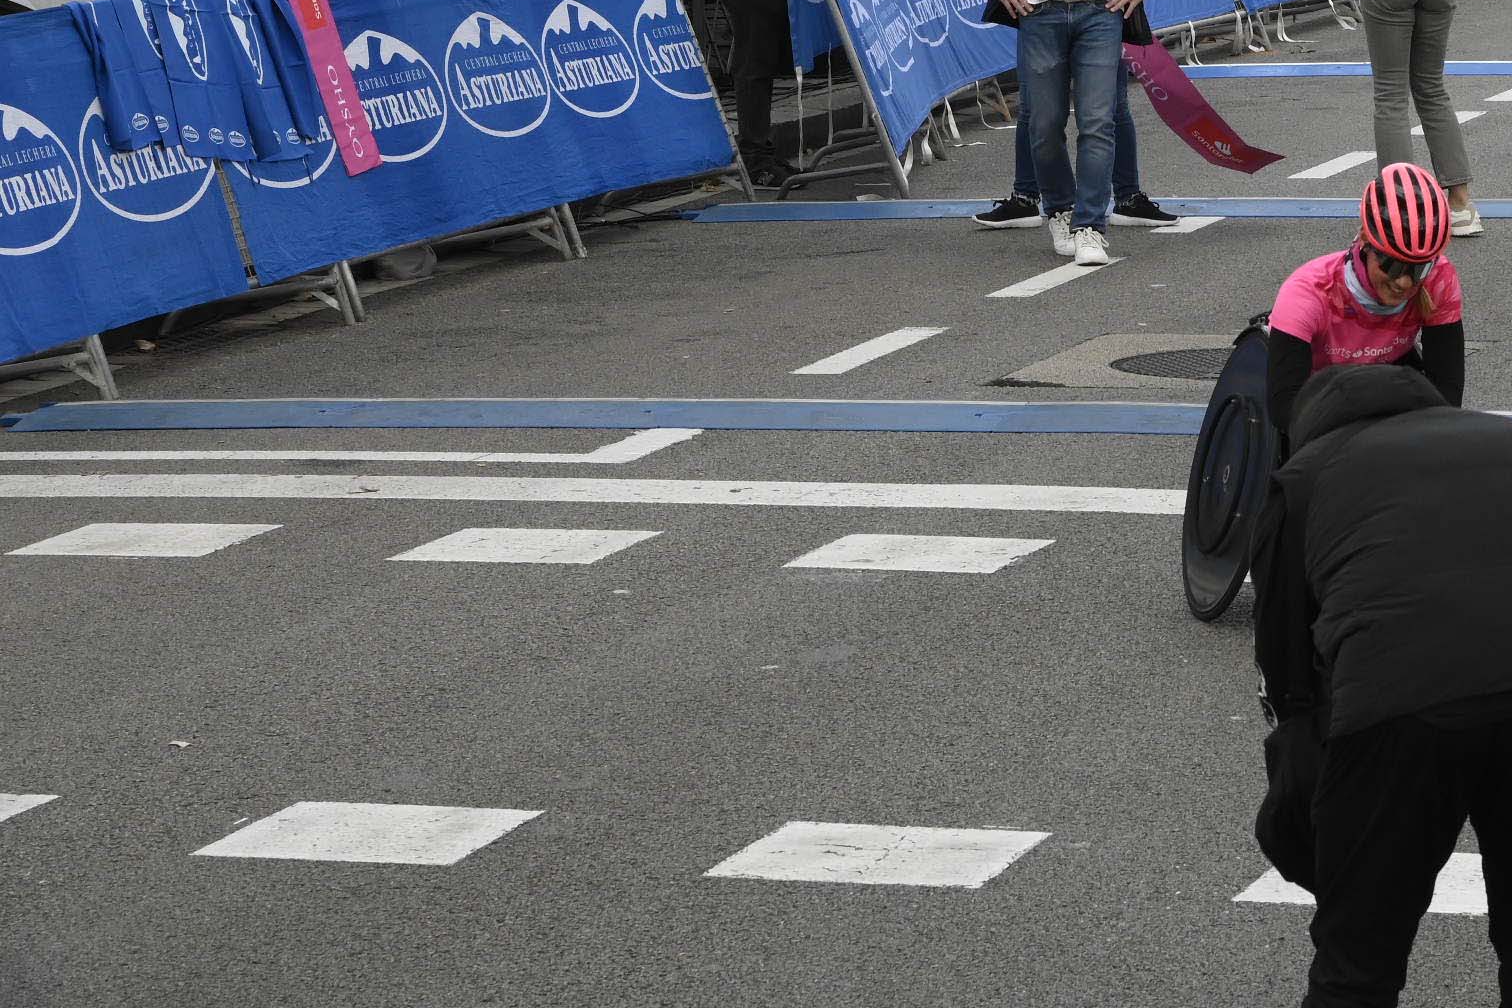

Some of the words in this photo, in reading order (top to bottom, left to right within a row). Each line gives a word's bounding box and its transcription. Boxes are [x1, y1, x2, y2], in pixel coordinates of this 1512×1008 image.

[464, 54, 499, 70] CENTRAL
[499, 49, 531, 66] LECHERA
[558, 42, 588, 55] CENTRAL
[588, 36, 618, 52] LECHERA
[642, 32, 701, 76] ASTUR
[389, 67, 428, 86] LECHERA
[454, 62, 547, 111] ASTURIANA
[550, 46, 636, 93] ASTURIANA
[326, 64, 365, 159] OYSHO
[361, 85, 443, 133] STURIANA
[16, 144, 58, 163] LECHERA
